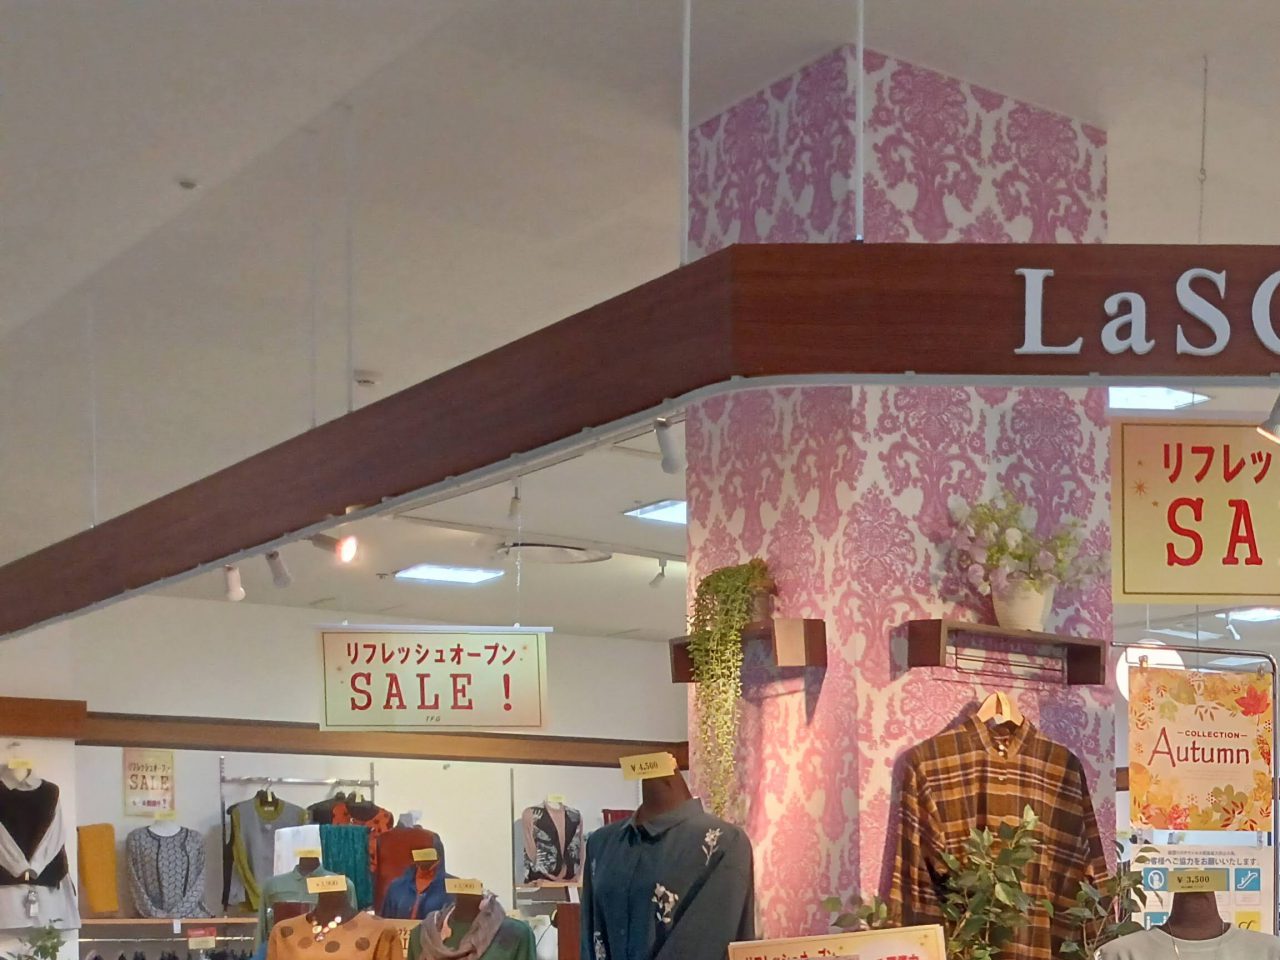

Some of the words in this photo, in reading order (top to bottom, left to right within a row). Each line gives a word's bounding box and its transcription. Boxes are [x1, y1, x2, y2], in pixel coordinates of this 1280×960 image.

[346, 642, 516, 665] リフレッシュオープン
[1184, 730, 1240, 739] COLLECTION
[1147, 726, 1250, 768] Autumn
[129, 774, 169, 790] SALE
